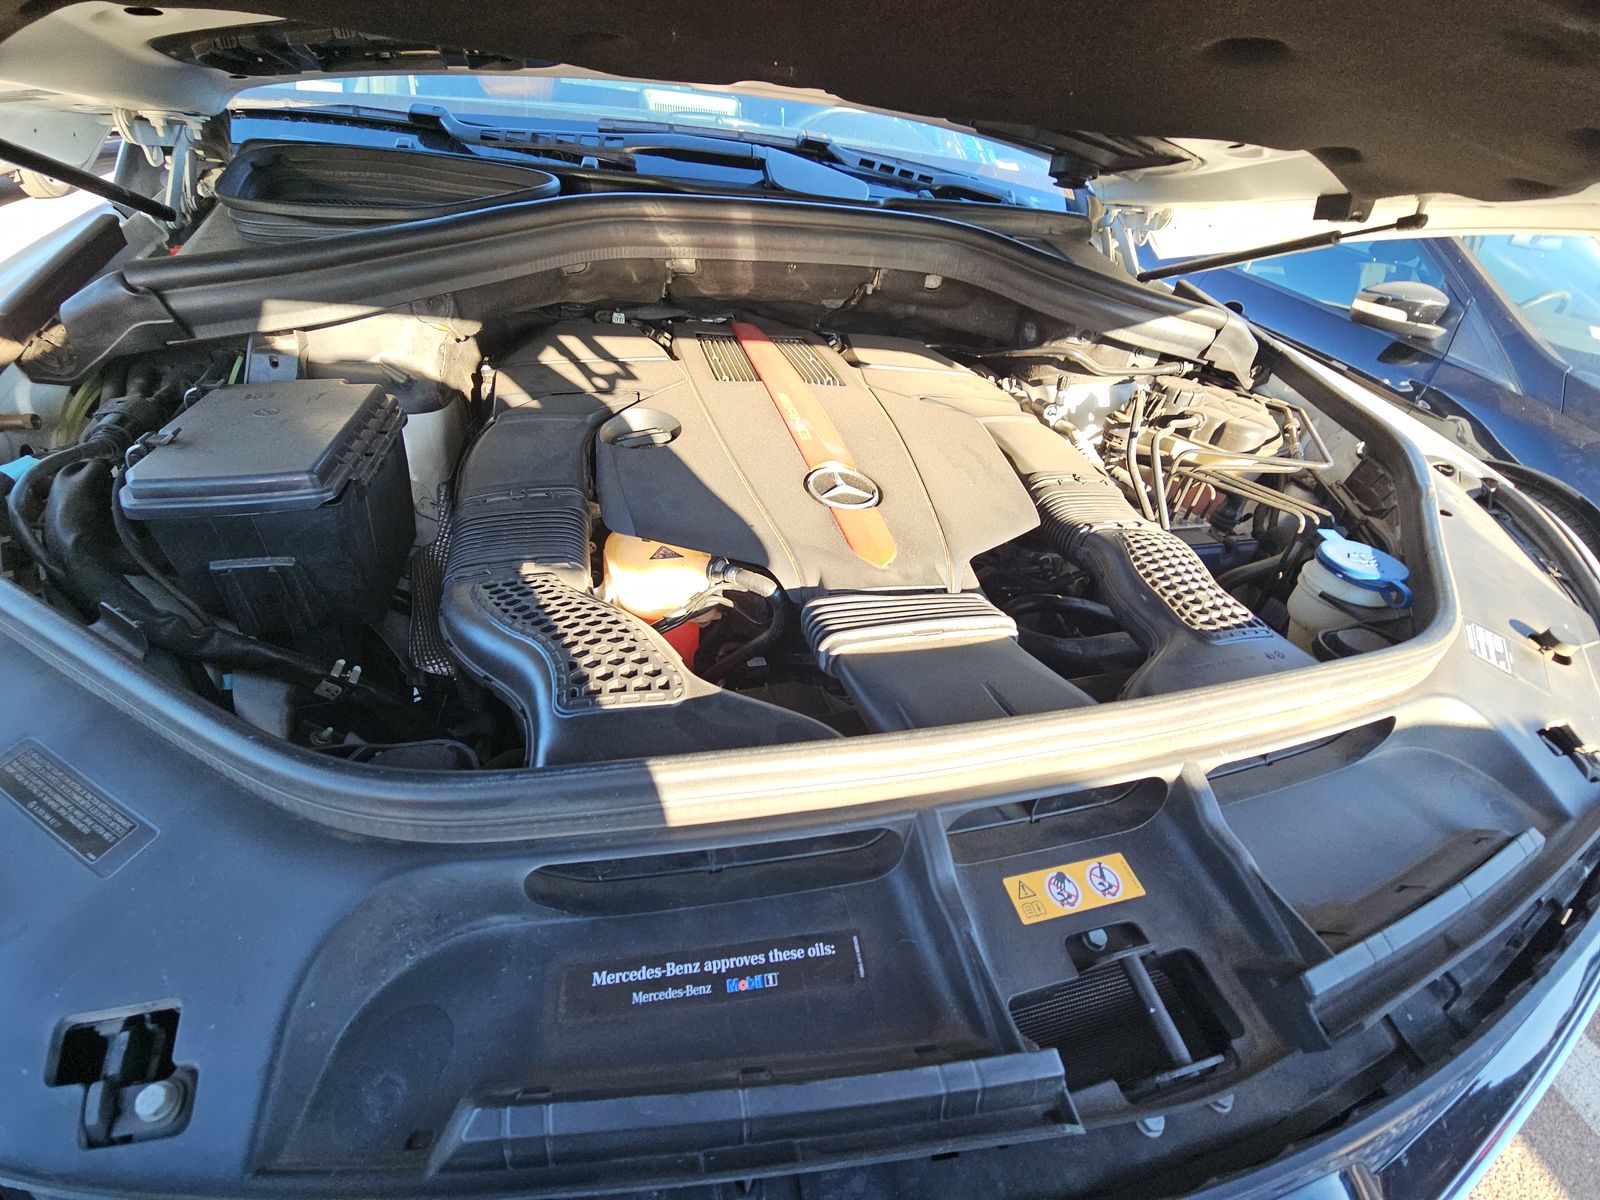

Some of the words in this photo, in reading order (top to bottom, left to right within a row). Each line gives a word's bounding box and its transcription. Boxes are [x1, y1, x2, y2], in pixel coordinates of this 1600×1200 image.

[784, 407, 812, 440] AMG
[592, 962, 700, 987] Mercedes-Benz
[704, 953, 766, 974] approves
[769, 948, 805, 963] these
[808, 942, 836, 957] oils:
[632, 984, 712, 1004] Mercedes-Benz
[726, 974, 764, 993] Mobil
